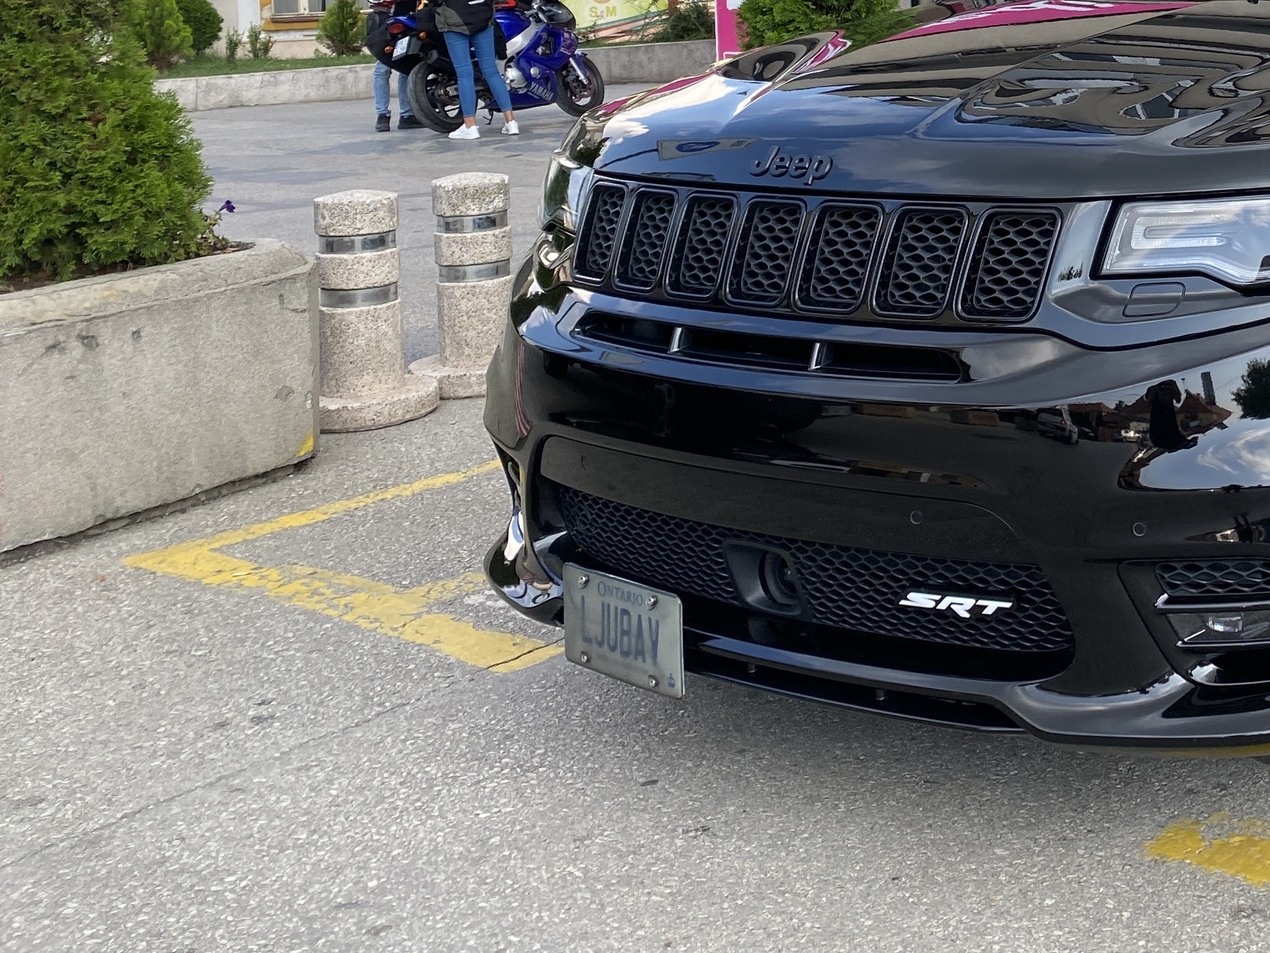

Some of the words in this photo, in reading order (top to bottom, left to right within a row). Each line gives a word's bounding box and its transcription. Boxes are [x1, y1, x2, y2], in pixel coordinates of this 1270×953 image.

[528, 81, 554, 102] YAMAHA
[749, 145, 833, 186] Jeep
[898, 591, 1013, 619] SRT
[580, 595, 660, 666] LJUBAY
